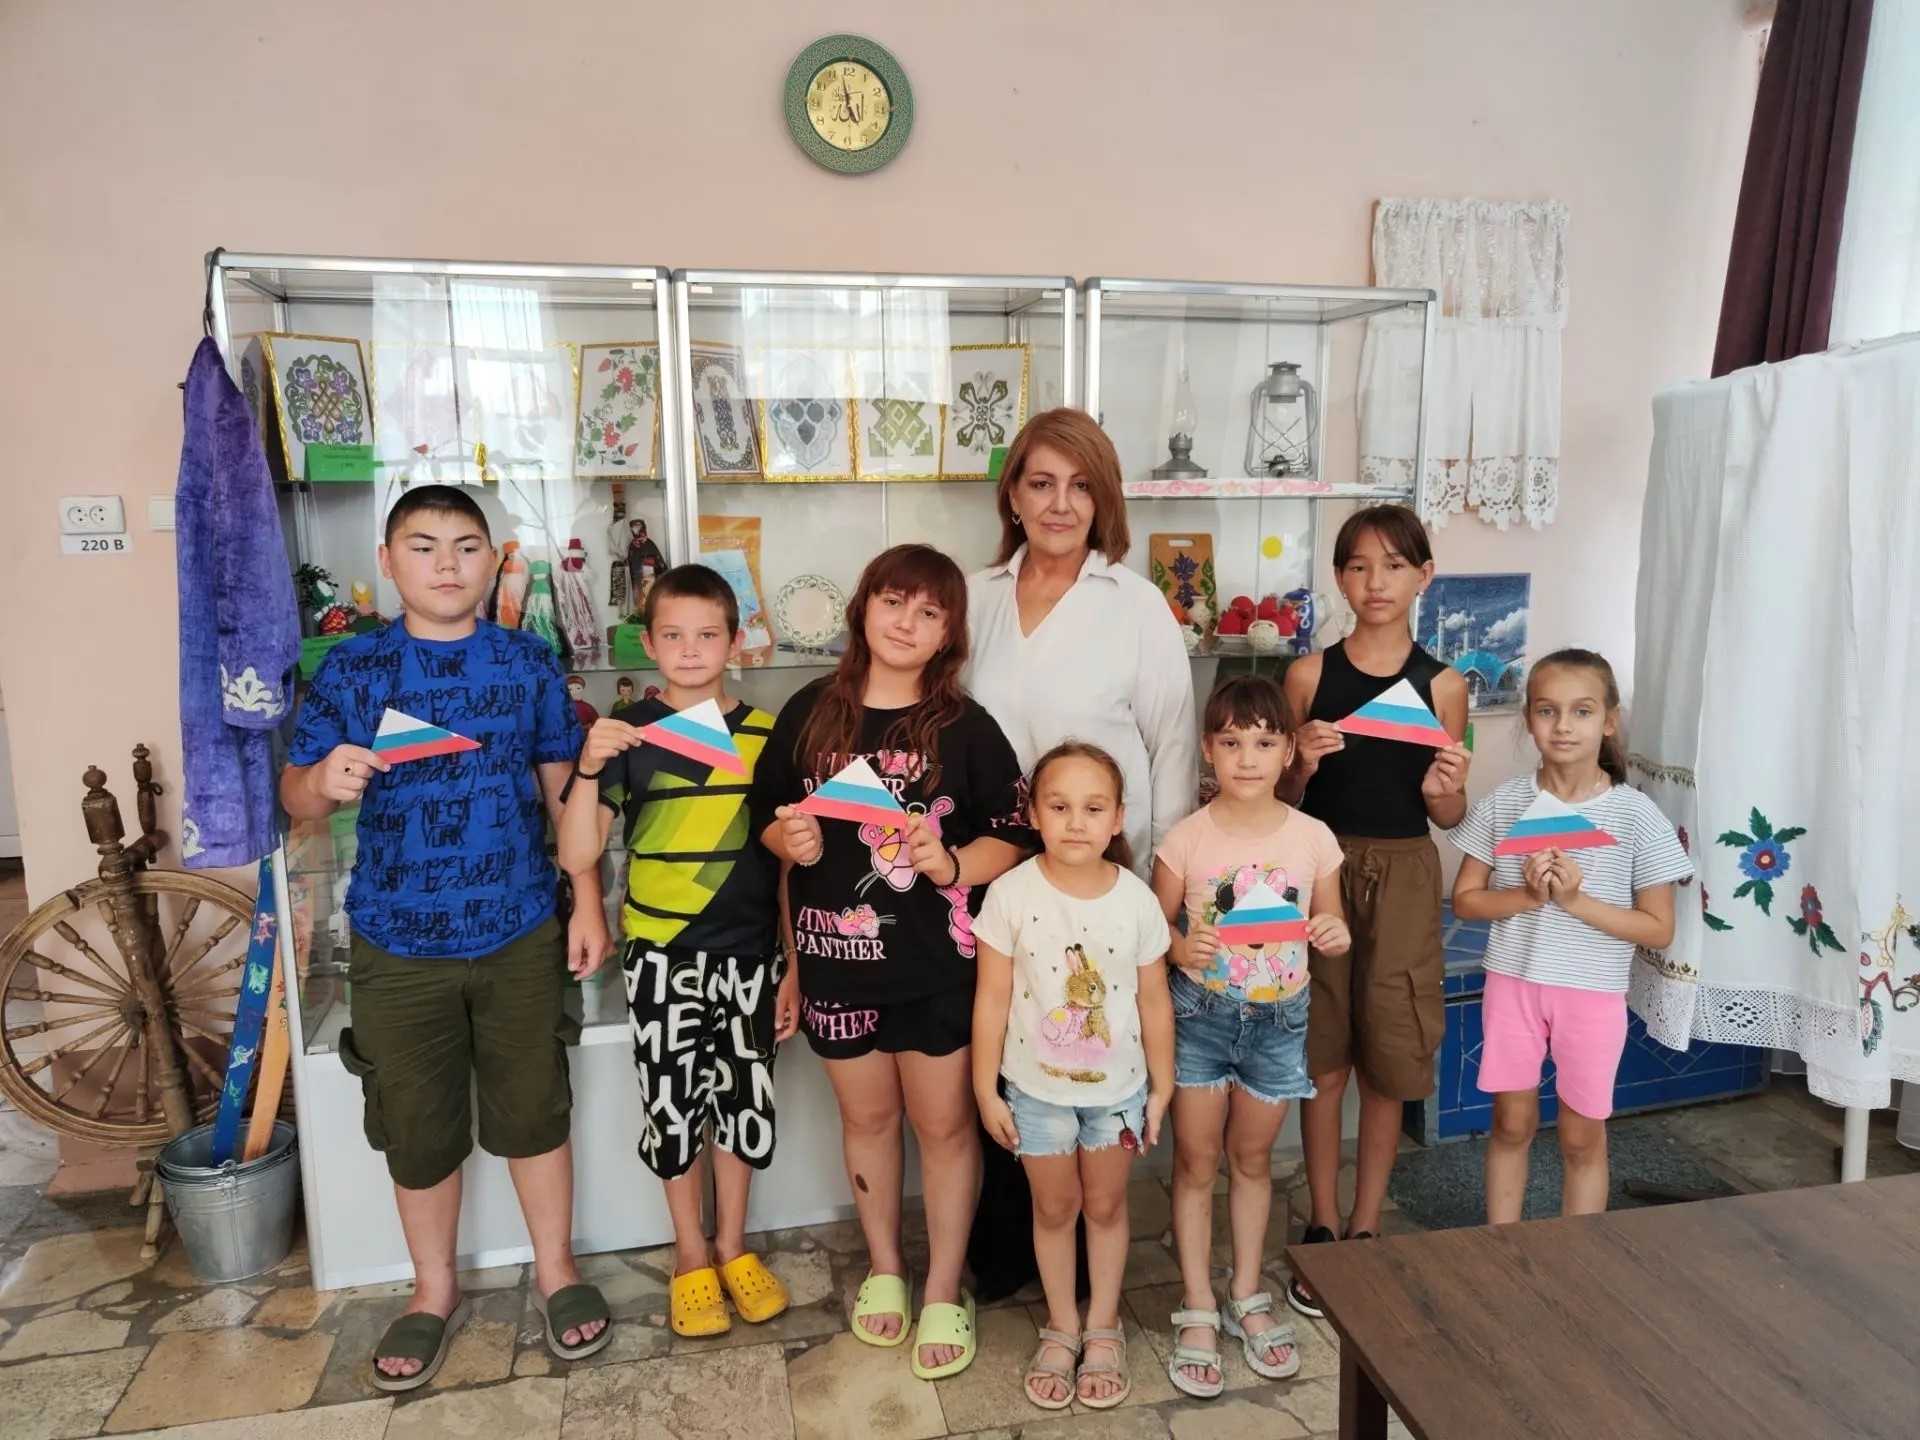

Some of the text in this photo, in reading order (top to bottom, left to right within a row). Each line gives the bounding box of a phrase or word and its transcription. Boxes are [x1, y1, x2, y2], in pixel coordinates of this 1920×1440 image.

[843, 67, 856, 78] 12
[873, 87, 882, 97] 2
[80, 539, 109, 551] 220
[796, 930, 887, 961] PANTHER
